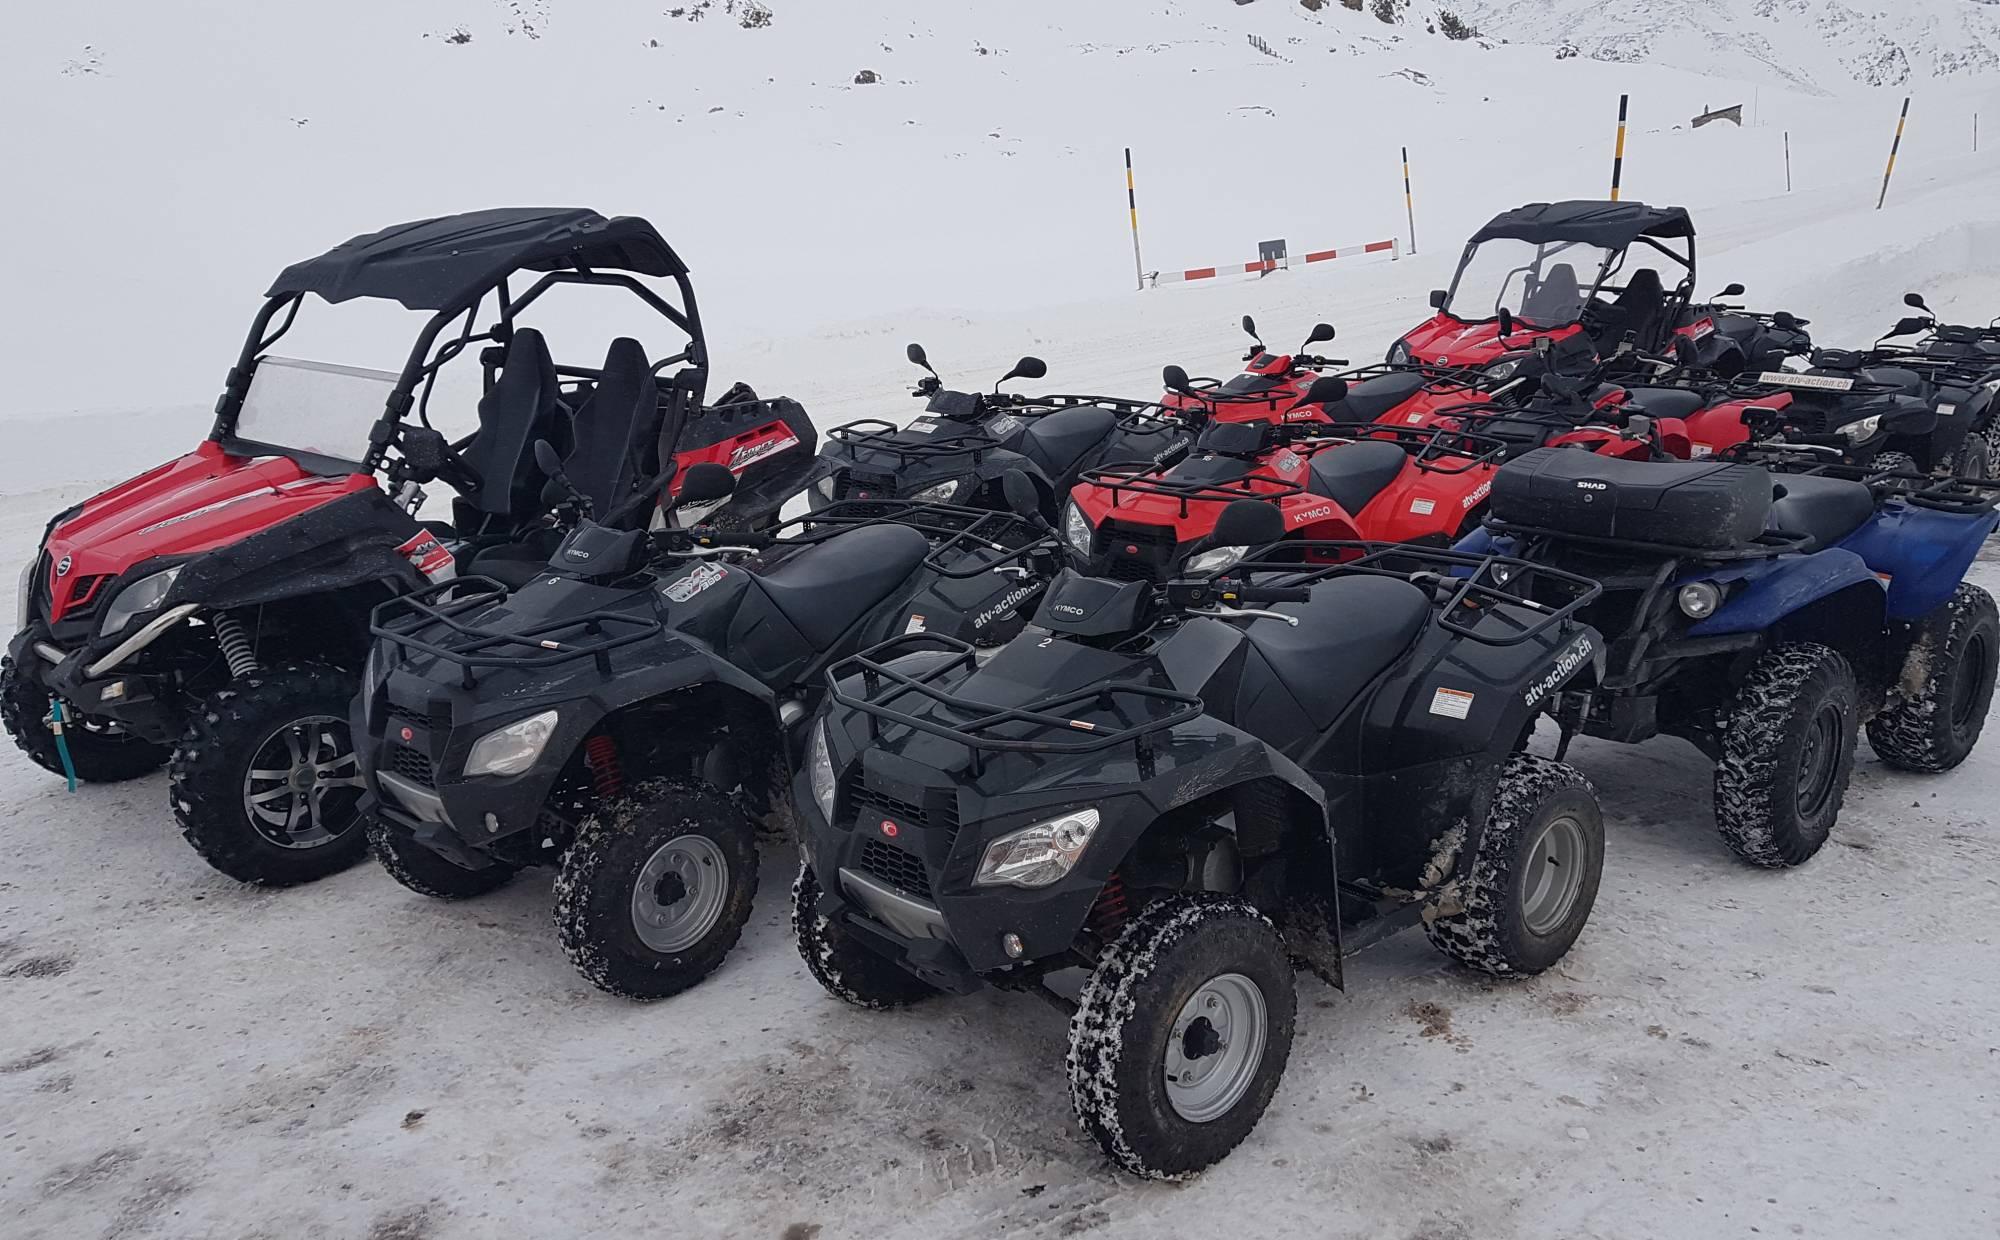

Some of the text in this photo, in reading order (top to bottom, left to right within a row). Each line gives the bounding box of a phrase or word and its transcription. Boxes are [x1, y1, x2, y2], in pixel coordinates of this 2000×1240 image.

[1761, 373, 1850, 389] www.atv-action.ch
[1576, 481, 1607, 490] SHAD
[1462, 480, 1492, 509] atv-action
[1293, 505, 1331, 523] KYMCO
[548, 577, 560, 585] 6
[974, 582, 1041, 629] atv-action.
[1055, 604, 1084, 616] KYMCO
[1037, 637, 1053, 648] 2
[1524, 638, 1593, 707] atv-action.ch
